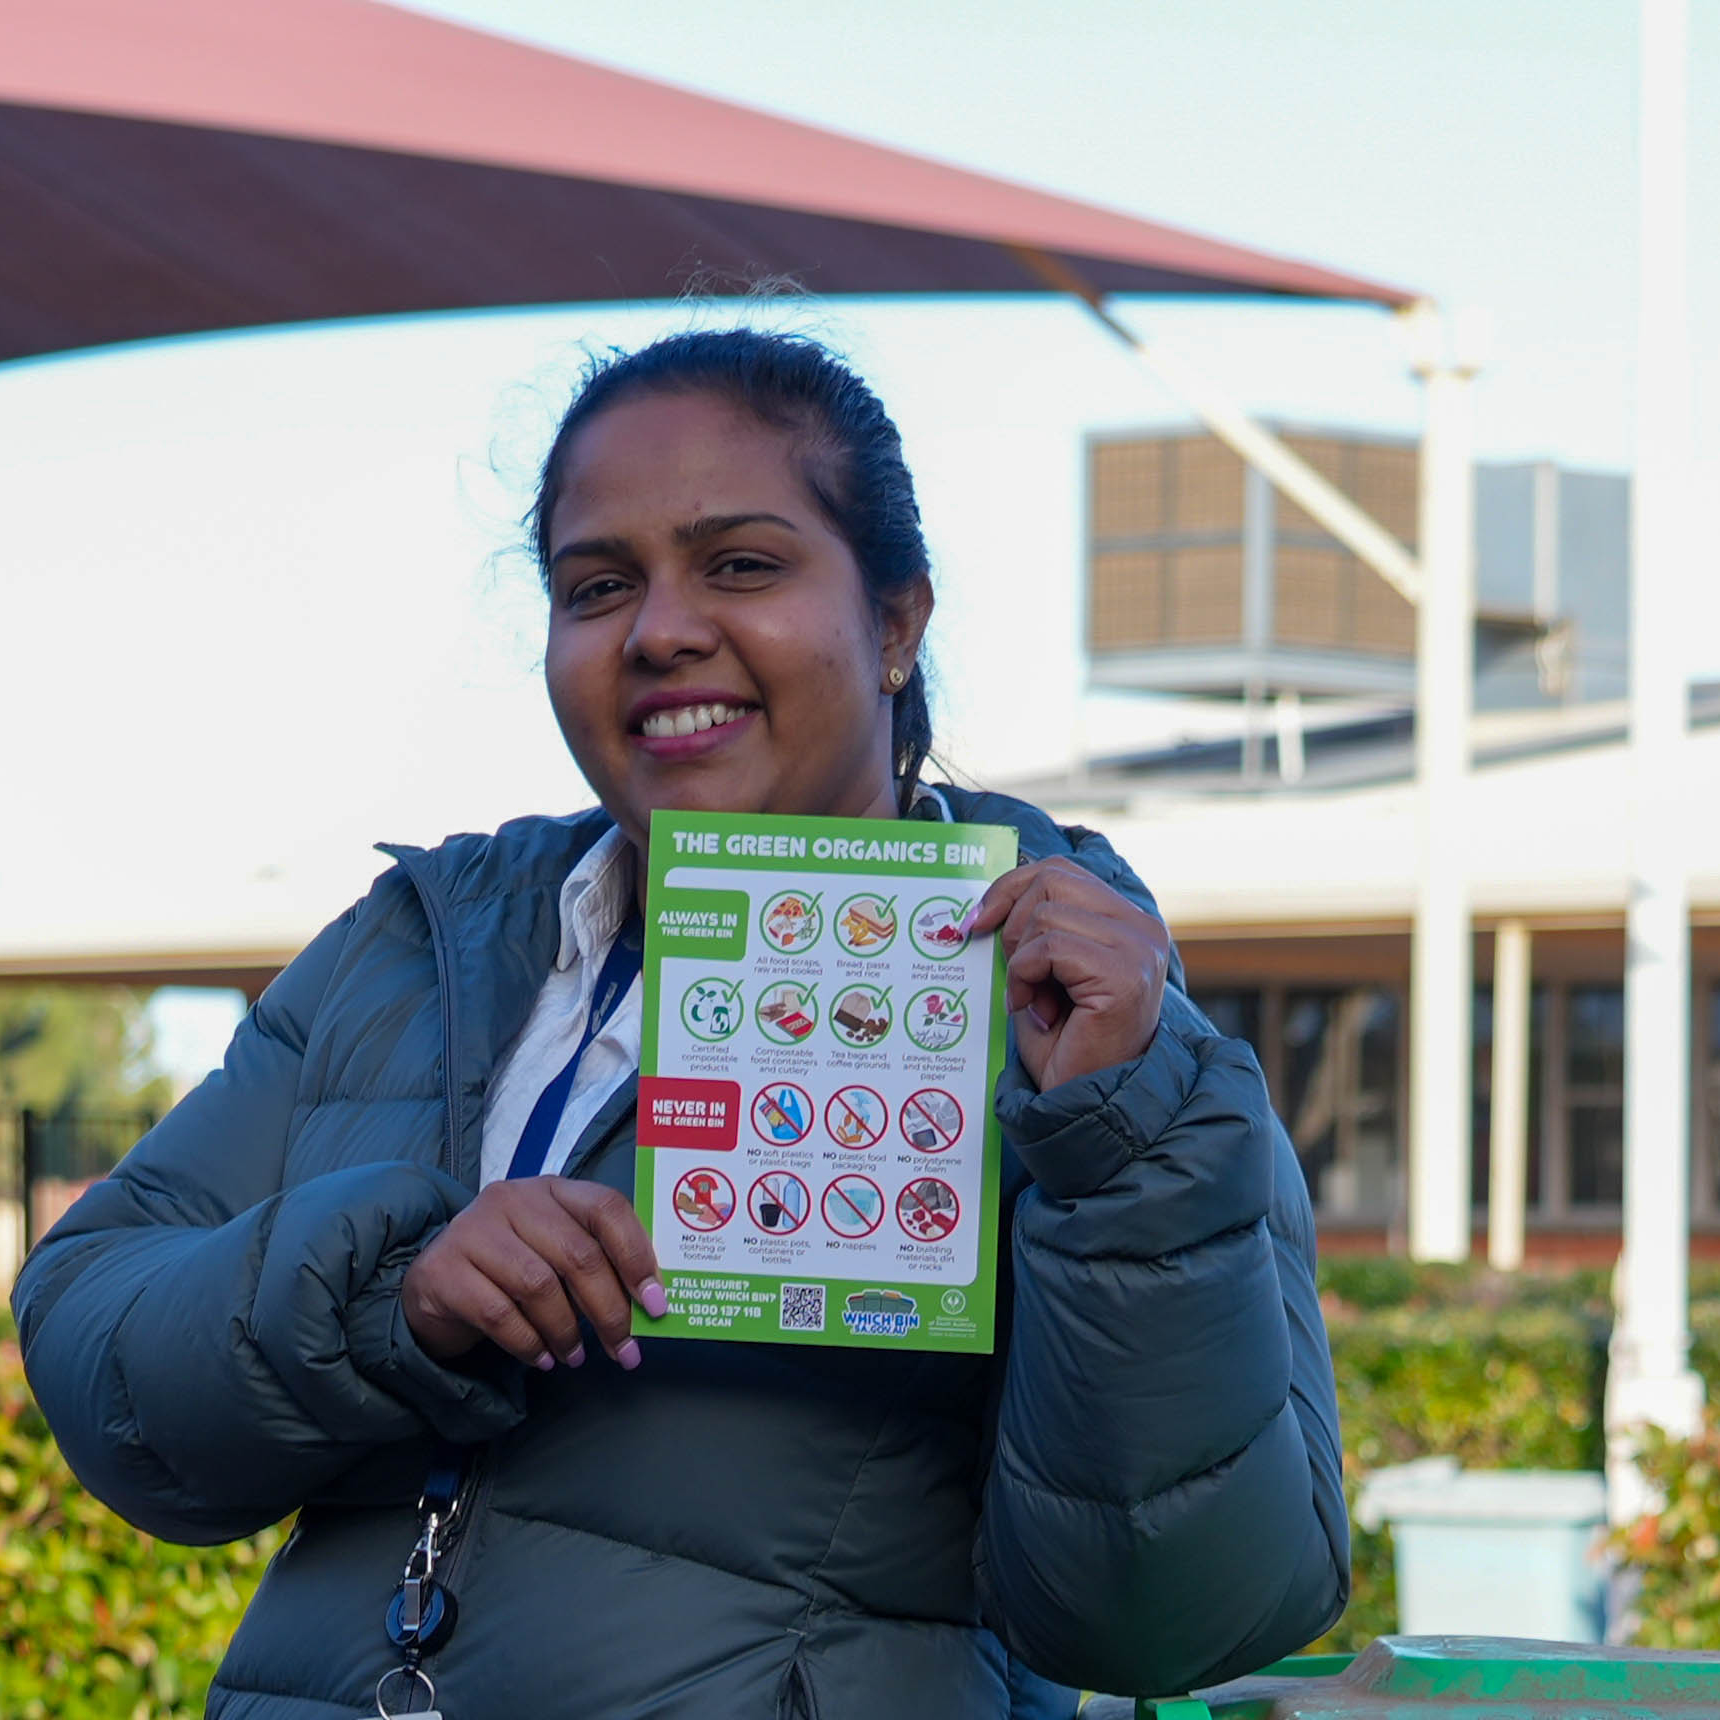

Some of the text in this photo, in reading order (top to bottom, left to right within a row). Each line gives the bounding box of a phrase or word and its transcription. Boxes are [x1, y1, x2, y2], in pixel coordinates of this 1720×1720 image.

[672, 831, 986, 865] THE GREEN ORGANICS BIN
[658, 911, 737, 927] ALWAYS IN
[662, 927, 733, 938] THE GREEN BIN
[792, 958, 820, 968] scraps,
[837, 959, 890, 971] Bread, pasta
[913, 963, 965, 972] Meat, bones
[772, 966, 788, 974] and
[846, 969, 880, 978] and rice
[911, 972, 965, 981] and seafood
[692, 1045, 729, 1053] Certified
[755, 1048, 813, 1058] Compostable
[682, 1054, 738, 1063] compostable
[751, 1056, 817, 1066] food containers
[831, 1052, 845, 1060] Tea
[848, 1052, 868, 1062] bags
[935, 1055, 966, 1064] flowers
[690, 1064, 729, 1072] products
[827, 1060, 890, 1070] coffee grounds
[904, 1063, 963, 1072] and shredded
[778, 1066, 808, 1075] cutlery
[921, 1073, 945, 1081] paper
[653, 1099, 726, 1116] NEVER IN
[653, 1116, 724, 1127] THE GREEN BIN
[763, 1150, 778, 1158] soft
[782, 1151, 813, 1160] plastics
[839, 1154, 865, 1163] plastic
[867, 1154, 886, 1162] food
[760, 1159, 788, 1167] plastic
[790, 1160, 811, 1168] bags
[913, 1157, 961, 1166] polystyrene
[832, 1162, 876, 1171] packaging
[925, 1164, 946, 1173] foam
[698, 1235, 724, 1244] fabric,
[744, 1237, 810, 1249] NO plastic pots,
[680, 1244, 715, 1253] clothing
[842, 1242, 876, 1251] nappies
[916, 1246, 952, 1255] building
[749, 1247, 794, 1256] containers
[684, 1252, 721, 1261] footwear
[762, 1256, 791, 1264] bottles
[896, 1253, 935, 1262] materials,
[920, 1263, 942, 1271] rocks
[672, 1278, 749, 1290] STILL UNSURE?
[680, 1290, 712, 1299] KNOW
[715, 1291, 749, 1301] WHICH
[752, 1293, 776, 1303] BIN?
[666, 1304, 685, 1314] ALL
[688, 1317, 732, 1327] OR SCAN
[843, 1312, 890, 1326] WHICH
[894, 1314, 920, 1328] BIN
[853, 1325, 907, 1335] SA.GOV.AU
